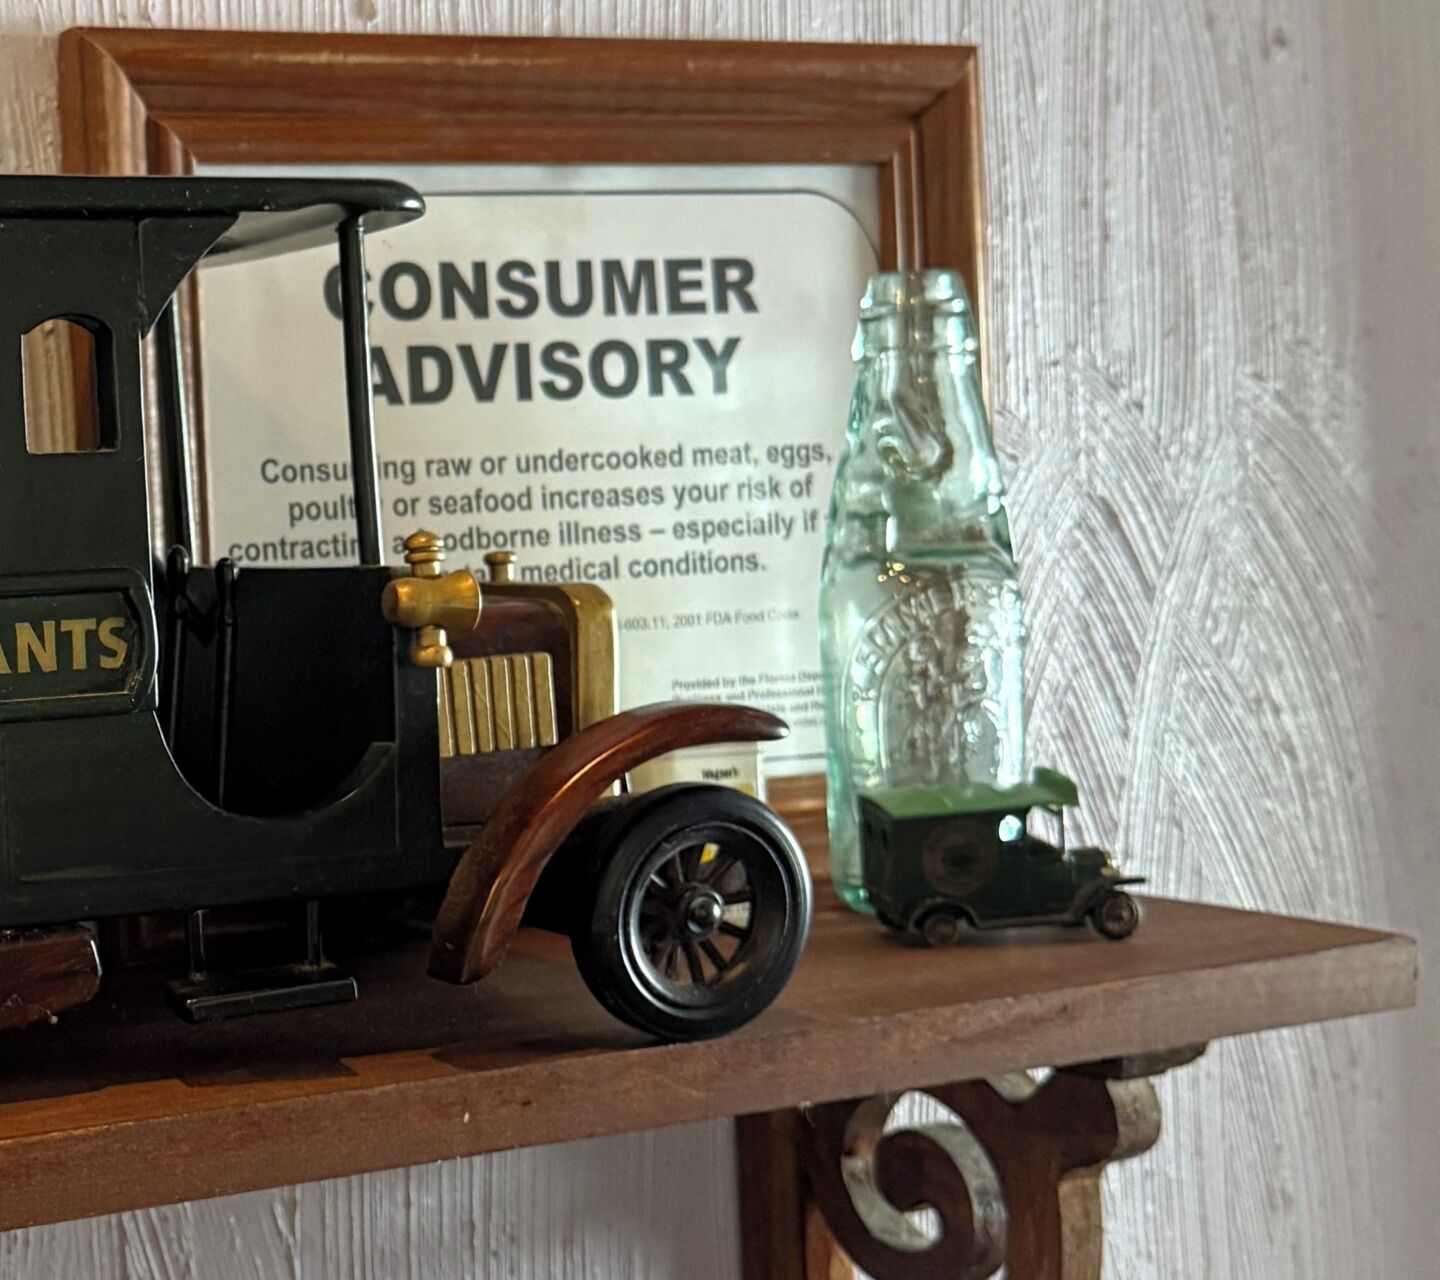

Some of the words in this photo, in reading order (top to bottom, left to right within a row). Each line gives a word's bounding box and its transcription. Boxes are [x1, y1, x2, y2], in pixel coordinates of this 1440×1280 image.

[323, 258, 759, 321] CONSUMER
[369, 336, 741, 406] ADVISORY
[261, 457, 416, 485] Consuing
[424, 455, 471, 478] raw
[480, 454, 507, 476] or
[517, 444, 683, 473] undercooked
[692, 441, 759, 467] meat,
[766, 442, 833, 470] eggs,
[288, 494, 384, 527] poult
[393, 496, 420, 518] or
[429, 486, 532, 516] seafood
[541, 484, 665, 511] increases
[672, 483, 729, 510] your
[737, 475, 781, 501] risk
[789, 473, 813, 498] of
[228, 532, 361, 562] contractin
[443, 525, 550, 553] odborne
[558, 521, 642, 547] illness
[672, 512, 794, 545] especially
[803, 509, 819, 533] if
[521, 554, 619, 583] medical
[627, 549, 767, 580] conditions.
